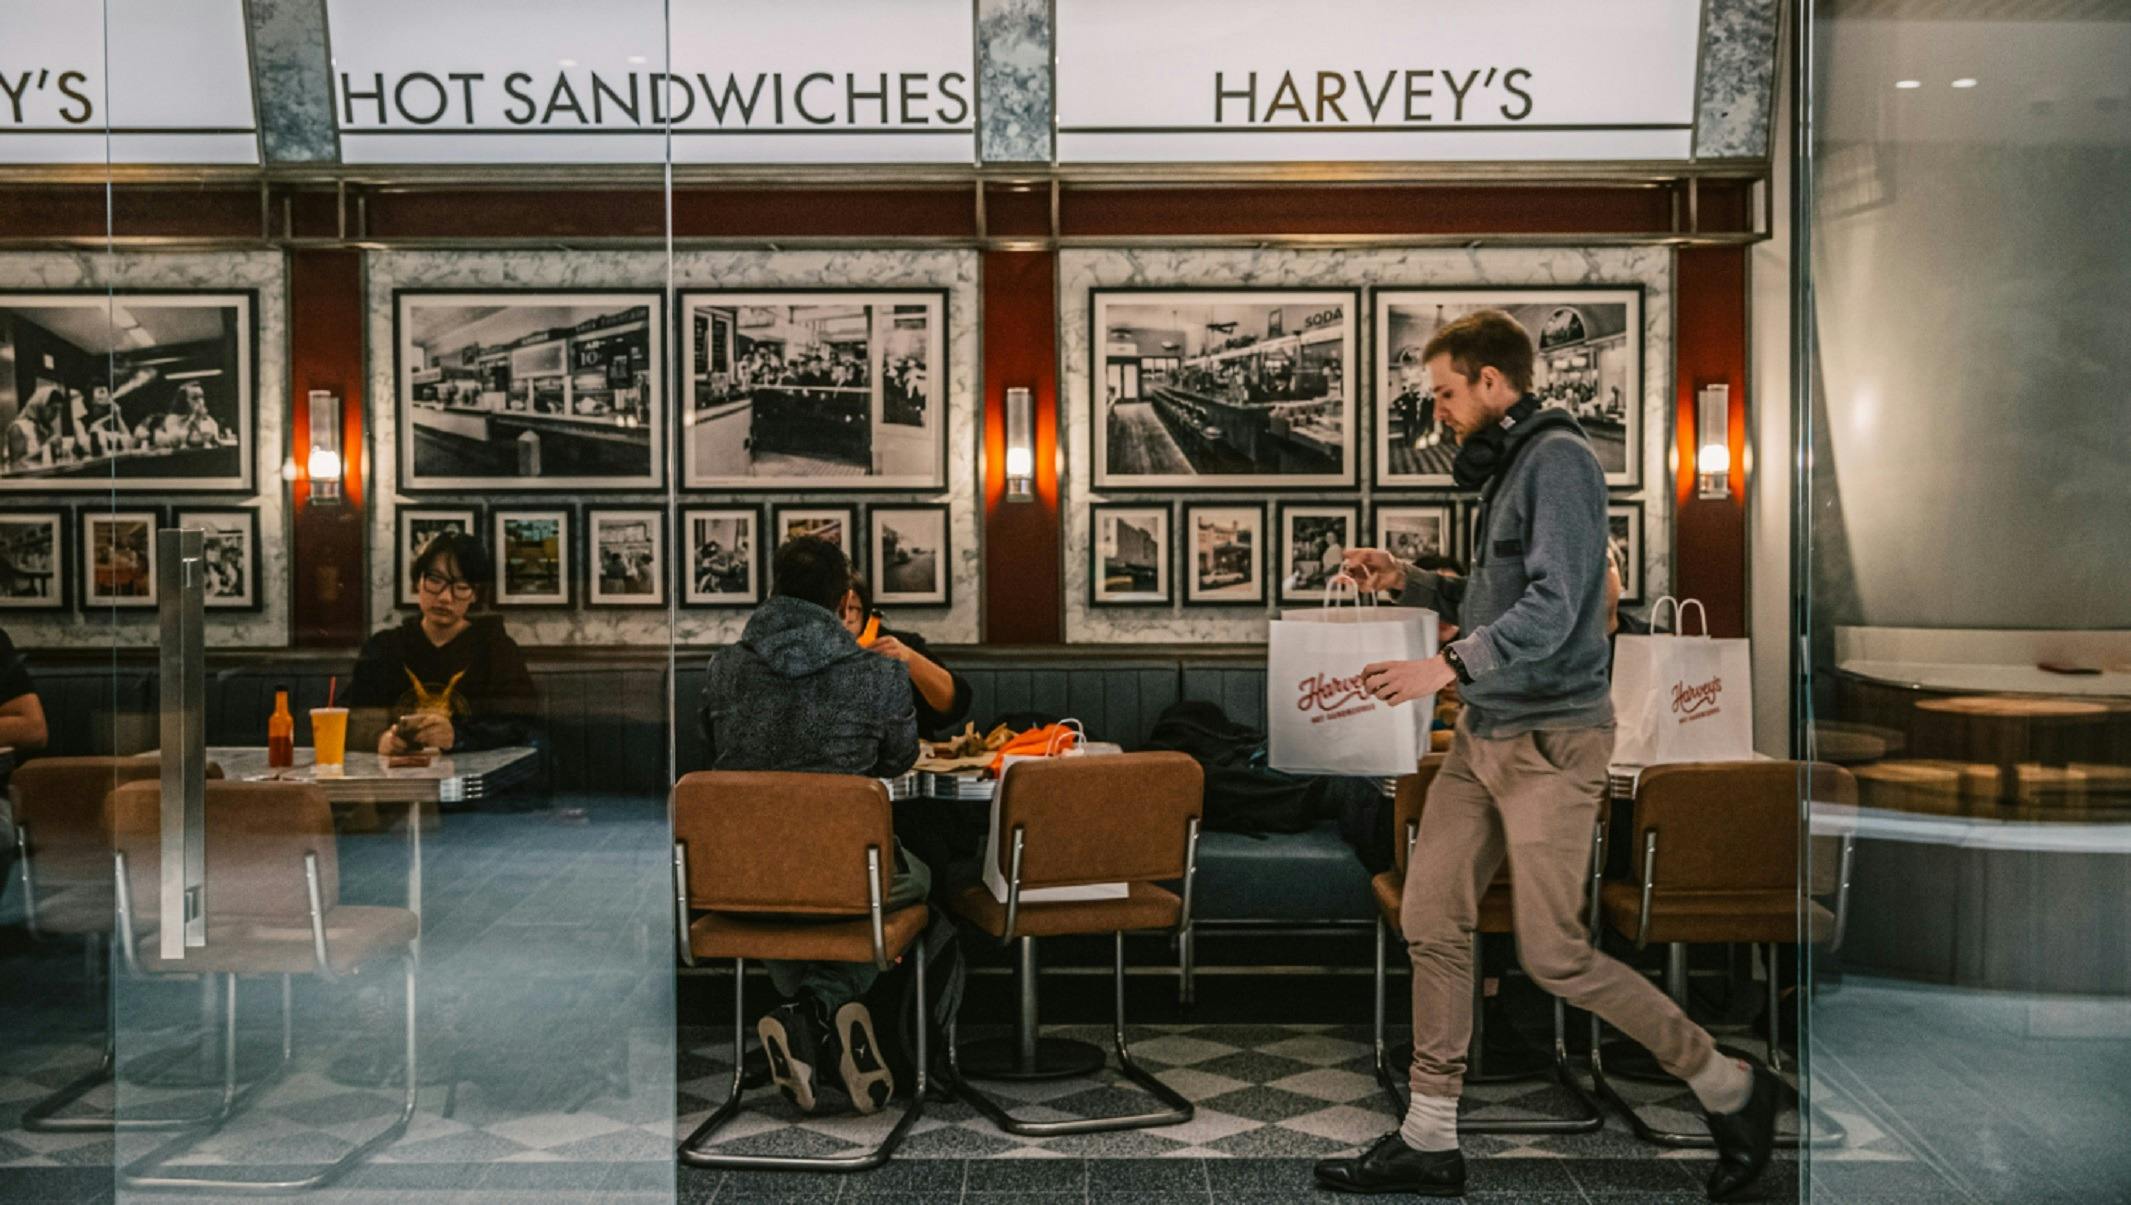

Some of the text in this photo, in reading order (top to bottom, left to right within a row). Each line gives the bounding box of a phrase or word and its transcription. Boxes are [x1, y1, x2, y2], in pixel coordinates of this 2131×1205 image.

[340, 69, 969, 126] HOT SANDWICHES
[1214, 66, 1533, 124] HARVEY'S
[1305, 307, 1343, 329] SODA
[1671, 675, 1722, 714] Harvey's
